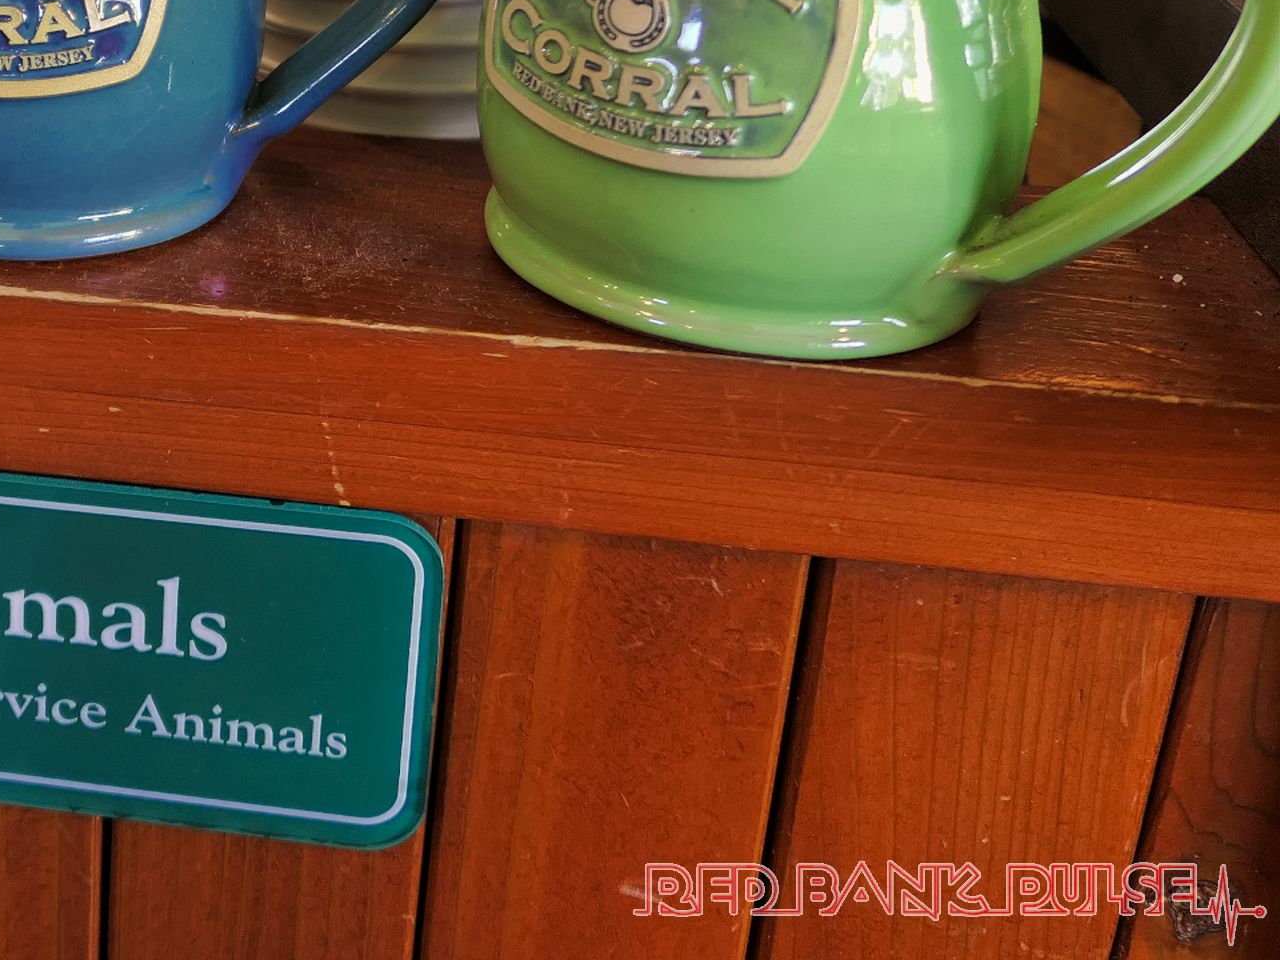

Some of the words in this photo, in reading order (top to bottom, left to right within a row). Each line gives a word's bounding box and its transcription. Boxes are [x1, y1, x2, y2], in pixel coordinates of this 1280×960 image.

[18, 44, 96, 73] JERSEY
[511, 60, 542, 92] RED
[599, 108, 651, 138] NEW
[650, 124, 743, 148] JERSEY
[125, 693, 348, 759] Animals
